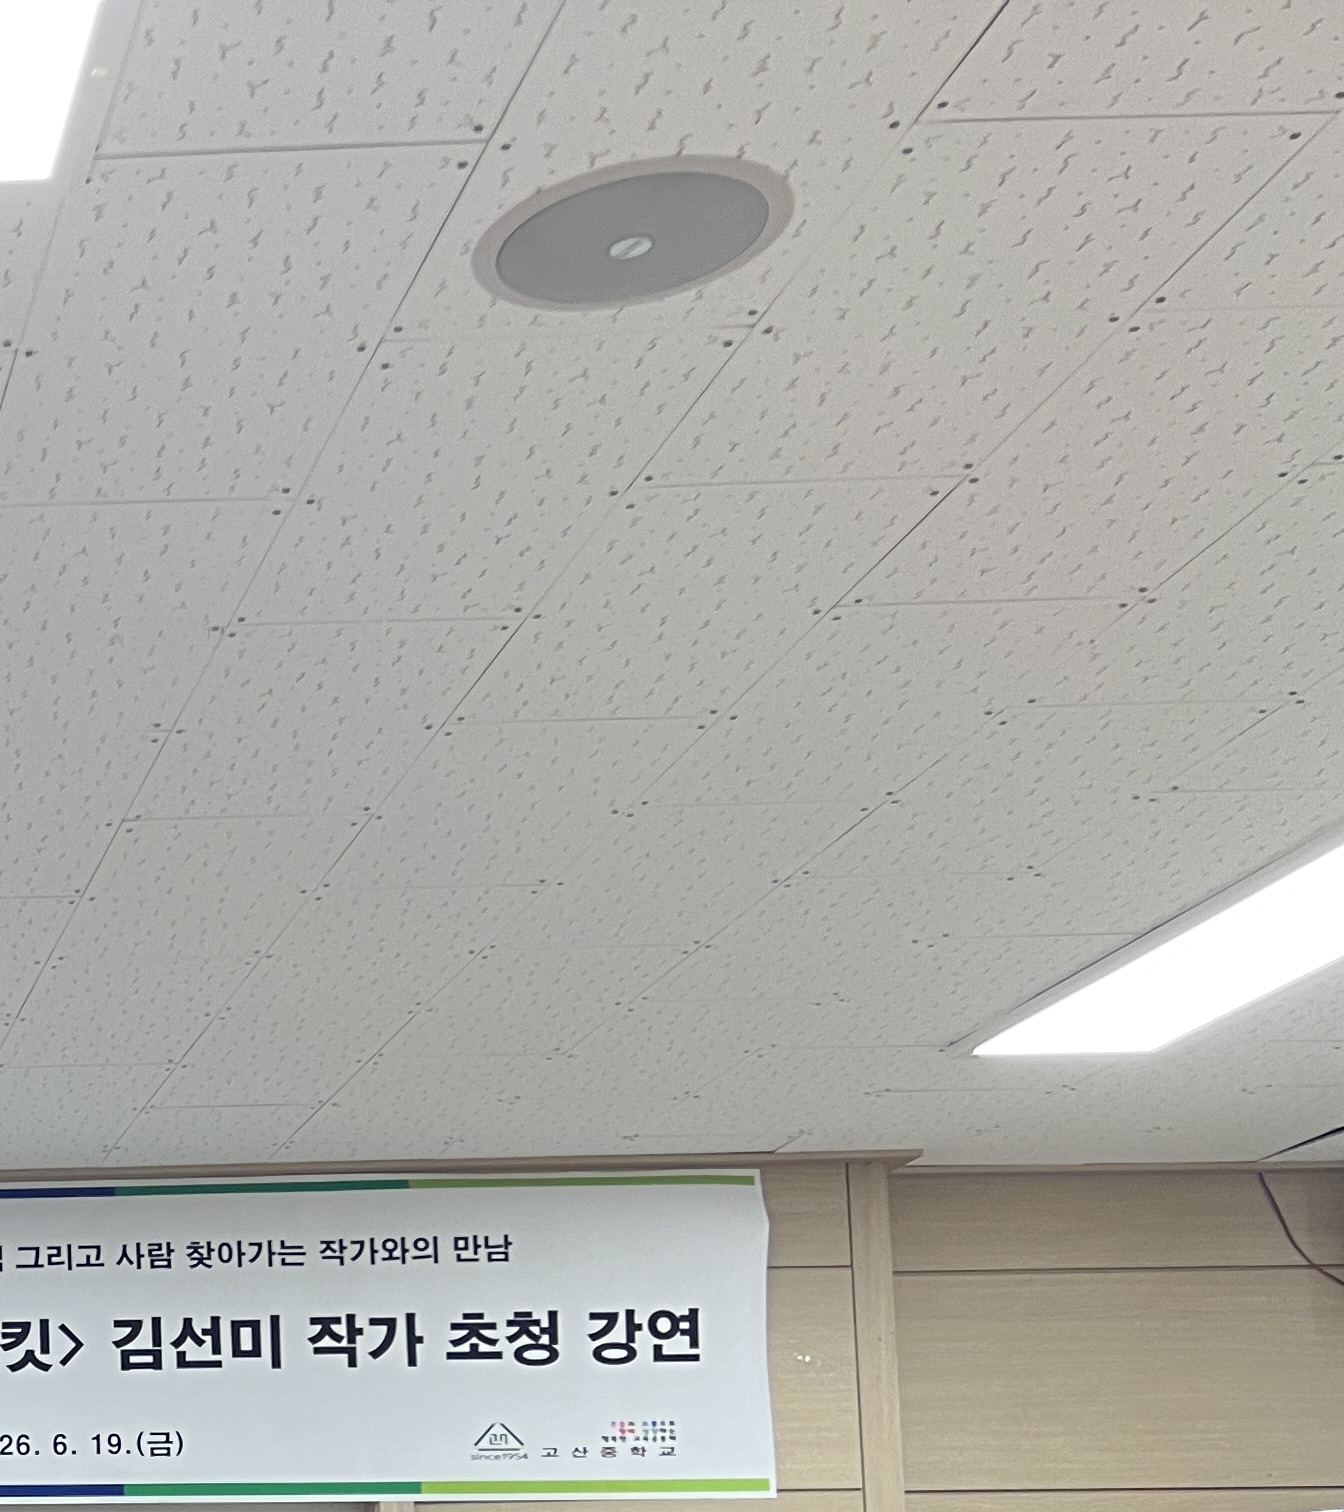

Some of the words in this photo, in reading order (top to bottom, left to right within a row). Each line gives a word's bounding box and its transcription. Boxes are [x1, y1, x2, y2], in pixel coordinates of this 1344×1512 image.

[15, 1243, 105, 1271] 그리고
[116, 1241, 174, 1270] 사람
[186, 1239, 307, 1269] 찾아가는
[319, 1236, 440, 1266] 작가와의
[452, 1233, 513, 1263] 만남
[112, 1314, 281, 1372] 김선미
[307, 1312, 424, 1368] 작가
[445, 1310, 561, 1367] 초청
[586, 1307, 701, 1366] 강연
[52, 1433, 77, 1455] 6.
[92, 1430, 184, 1458] 19.(금)
